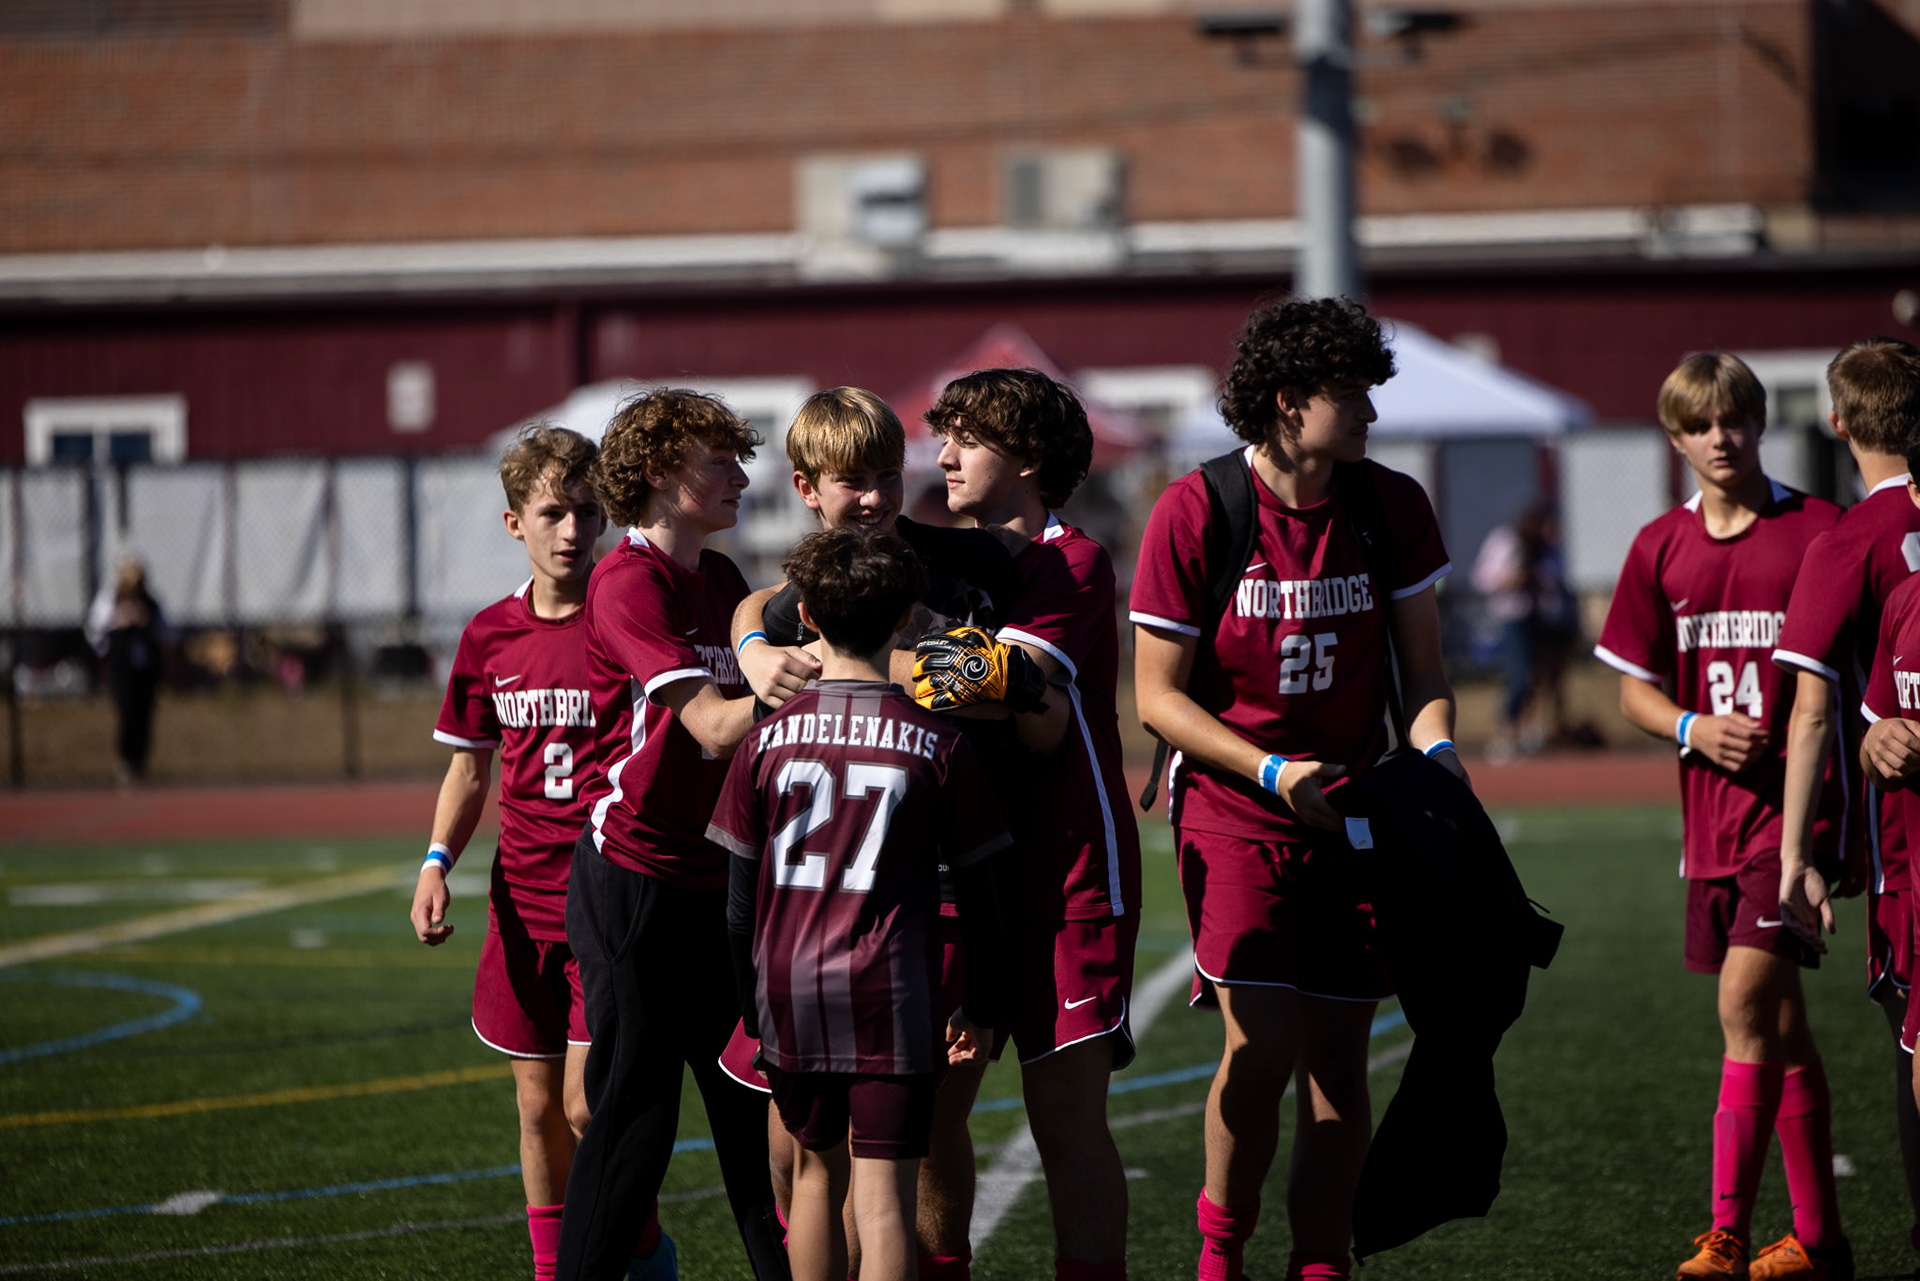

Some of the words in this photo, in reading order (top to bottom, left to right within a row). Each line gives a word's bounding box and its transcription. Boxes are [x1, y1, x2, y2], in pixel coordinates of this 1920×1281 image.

[1278, 631, 1339, 695] 25
[1706, 660, 1763, 718] 24
[1893, 670, 1920, 710] ORT
[491, 687, 597, 729] NORTHBRI
[757, 713, 939, 760] MANDELENAKIS
[543, 742, 574, 800] 2
[771, 758, 909, 894] 27
